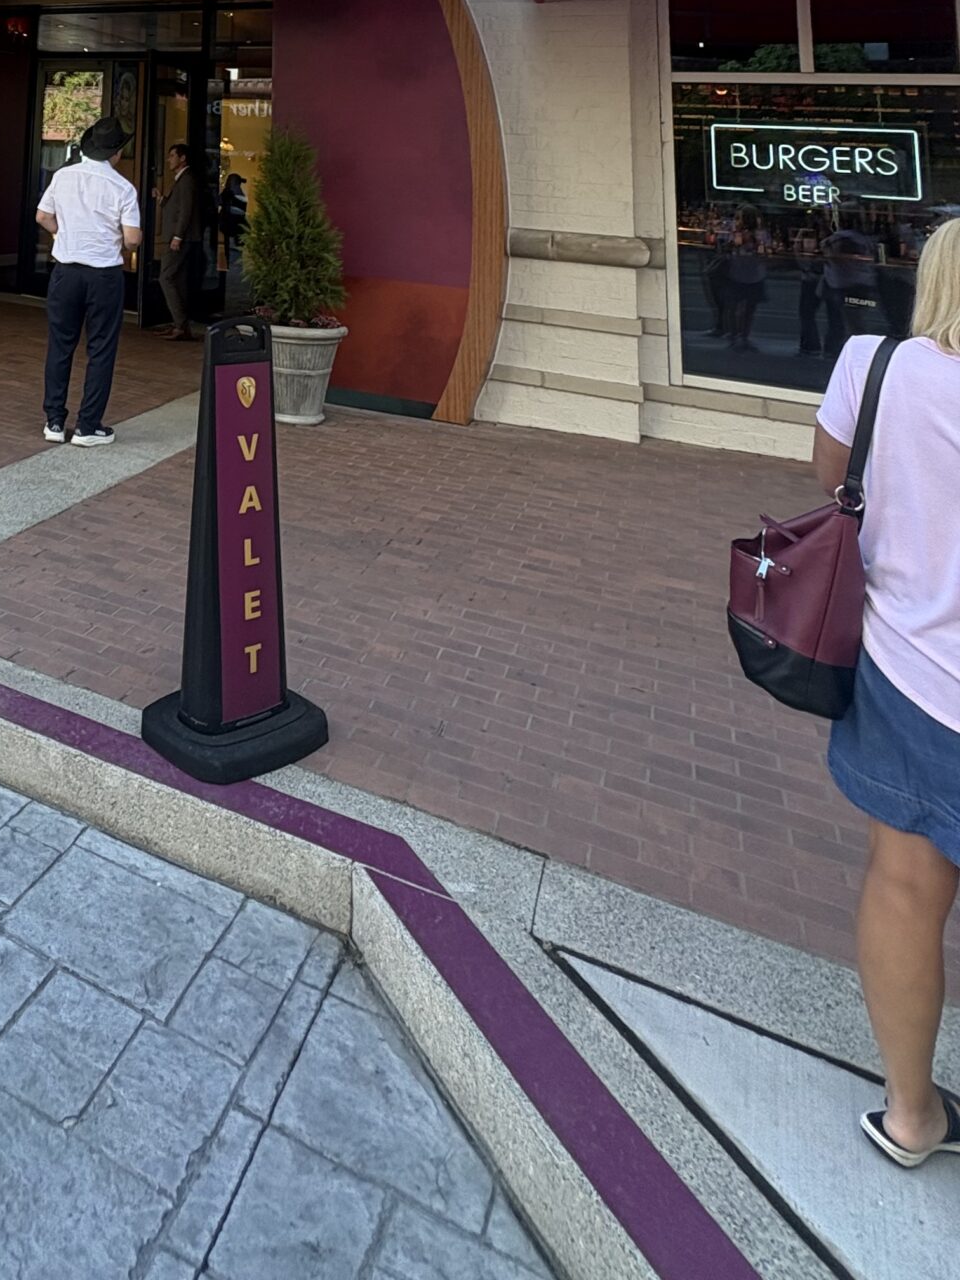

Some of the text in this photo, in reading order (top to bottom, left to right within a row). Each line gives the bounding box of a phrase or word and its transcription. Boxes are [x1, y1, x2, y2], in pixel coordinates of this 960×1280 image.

[730, 142, 898, 176] BURGERS
[783, 183, 841, 204] BEER
[237, 433, 262, 674] VALET
